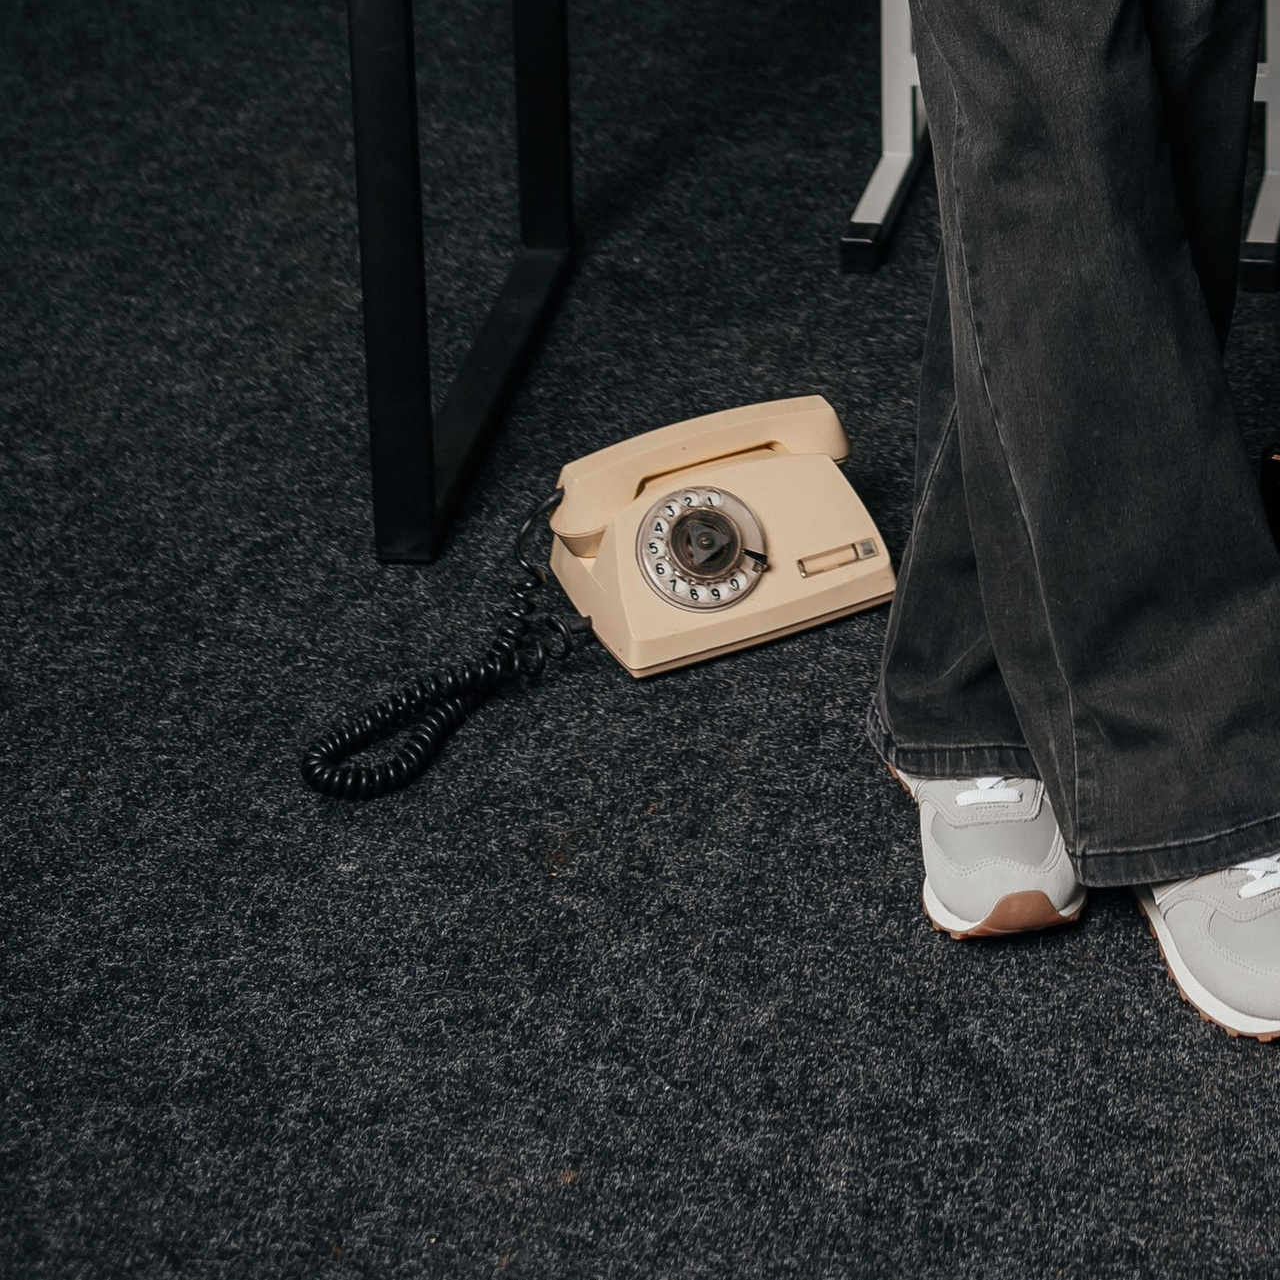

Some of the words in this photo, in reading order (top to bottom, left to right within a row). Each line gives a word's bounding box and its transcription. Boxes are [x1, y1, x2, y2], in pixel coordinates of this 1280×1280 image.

[684, 497, 692, 507] 2
[707, 497, 714, 506] 1
[665, 505, 675, 517] 3
[654, 522, 664, 533] 4
[649, 542, 659, 554] 5
[655, 563, 665, 574] 6
[669, 579, 677, 592] 7
[690, 588, 699, 601] 8
[711, 588, 720, 601] 9
